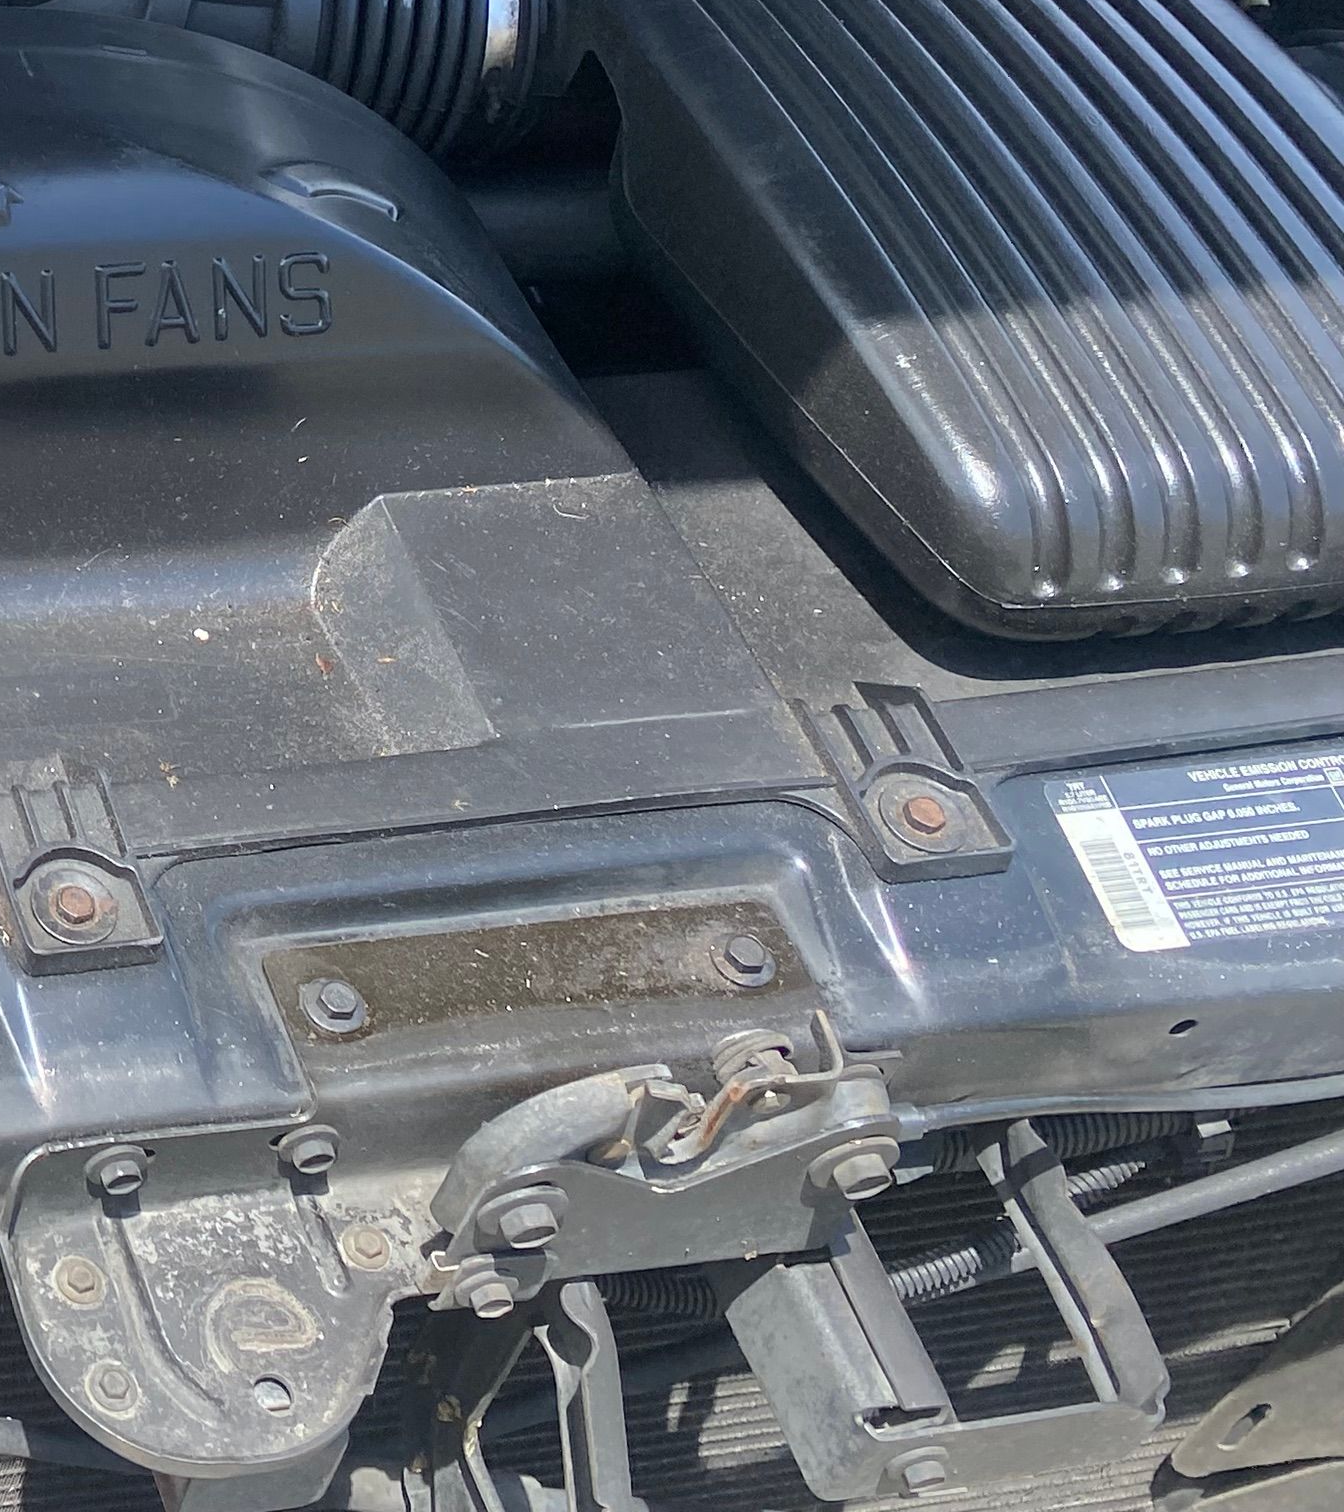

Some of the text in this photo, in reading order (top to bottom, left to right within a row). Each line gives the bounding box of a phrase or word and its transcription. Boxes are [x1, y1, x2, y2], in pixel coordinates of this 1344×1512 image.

[94, 252, 334, 351] FANS
[1187, 766, 1241, 782] VEHICLE
[1239, 760, 1298, 777] EMISSION
[1280, 773, 1325, 786] Corporation
[1132, 816, 1171, 828] SPARK
[1170, 812, 1202, 825] PLUG
[1202, 810, 1226, 821] GAP
[1255, 801, 1301, 816] INCHES.
[1147, 830, 1310, 856] NO OTHER ADJUSTMENTS NEEDED
[1159, 869, 1180, 879] SEE
[1180, 863, 1223, 876] SERVICE
[1222, 859, 1266, 872] MANUAL
[1266, 856, 1287, 867] AND
[1165, 876, 1219, 891] SCHEDULE
[1217, 873, 1241, 884] FOR
[1240, 868, 1300, 882] ADDITIONAL
